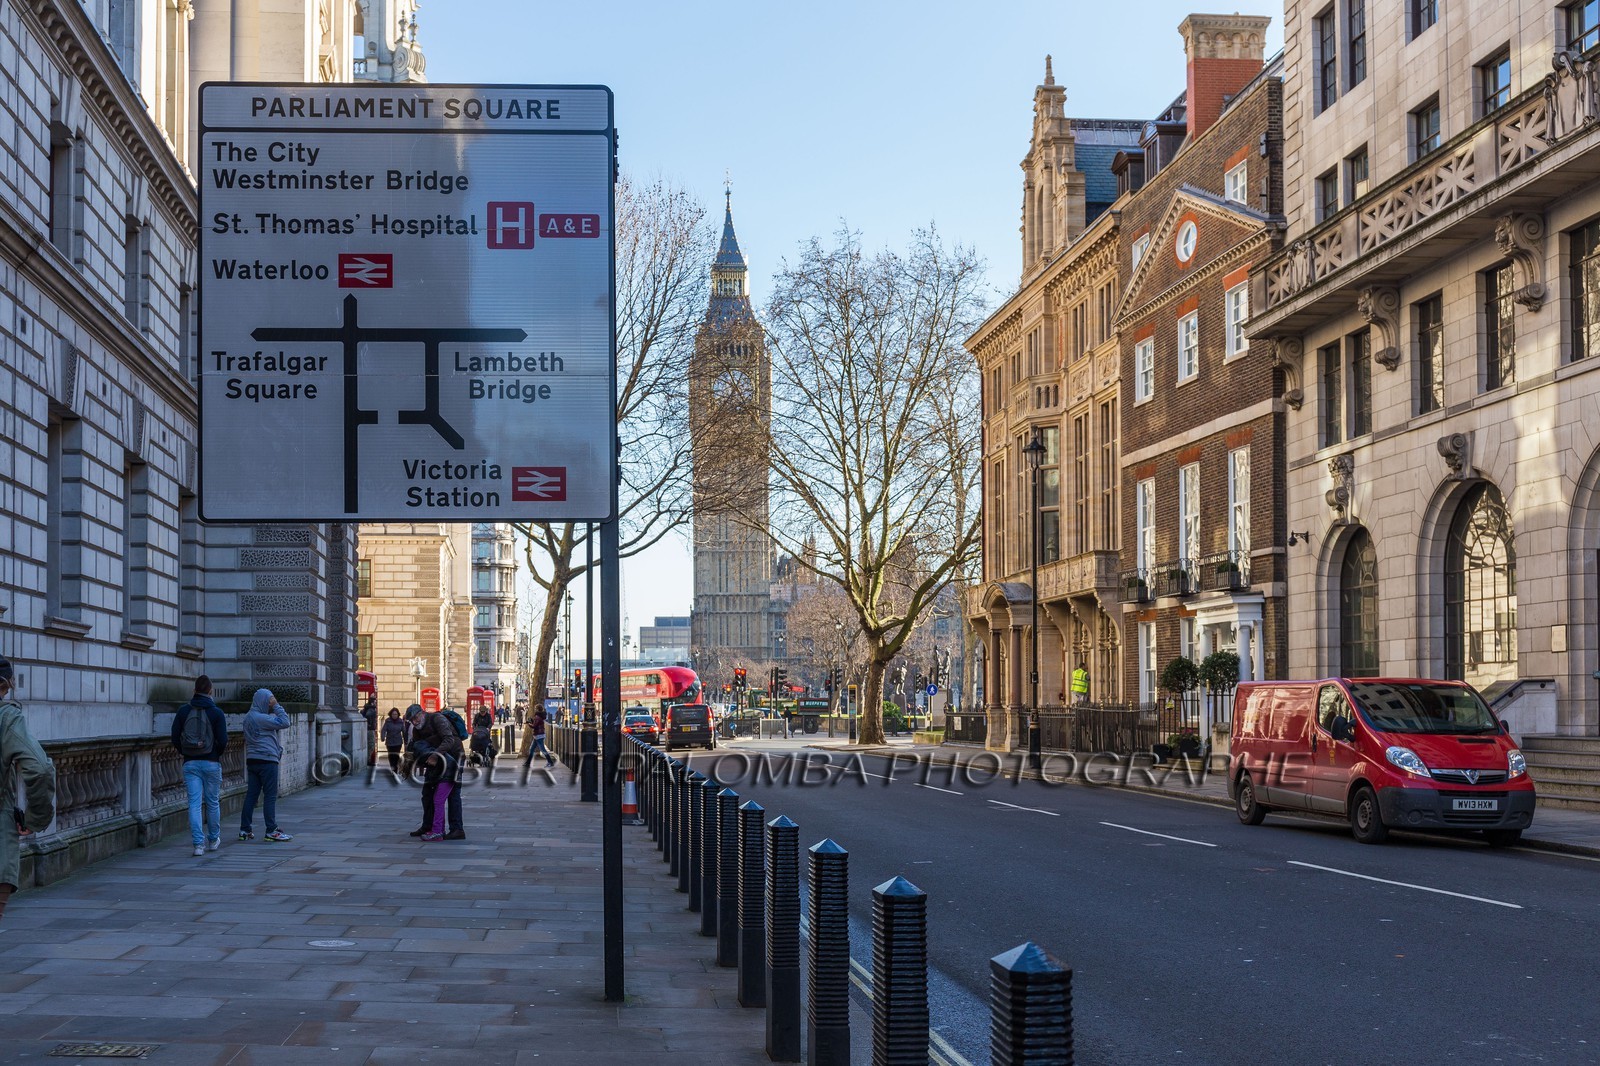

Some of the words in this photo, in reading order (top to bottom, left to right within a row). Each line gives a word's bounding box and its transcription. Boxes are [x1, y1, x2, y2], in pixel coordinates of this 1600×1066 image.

[251, 97, 434, 119] PARLIAMENT
[443, 98, 562, 121] SQUARE
[211, 141, 258, 163] The
[267, 141, 321, 167] City
[212, 168, 375, 190] Westminster
[386, 169, 470, 195] Bridge
[211, 212, 249, 235] St.
[371, 213, 478, 239] Hospital
[495, 207, 526, 244] H
[212, 259, 330, 281] Waterloo
[211, 350, 328, 376] Trafalgar
[453, 351, 564, 374] Lambeth
[225, 378, 318, 403] Square
[468, 379, 552, 404] Bridge
[402, 459, 503, 480] Victoria
[405, 486, 500, 508] Station
